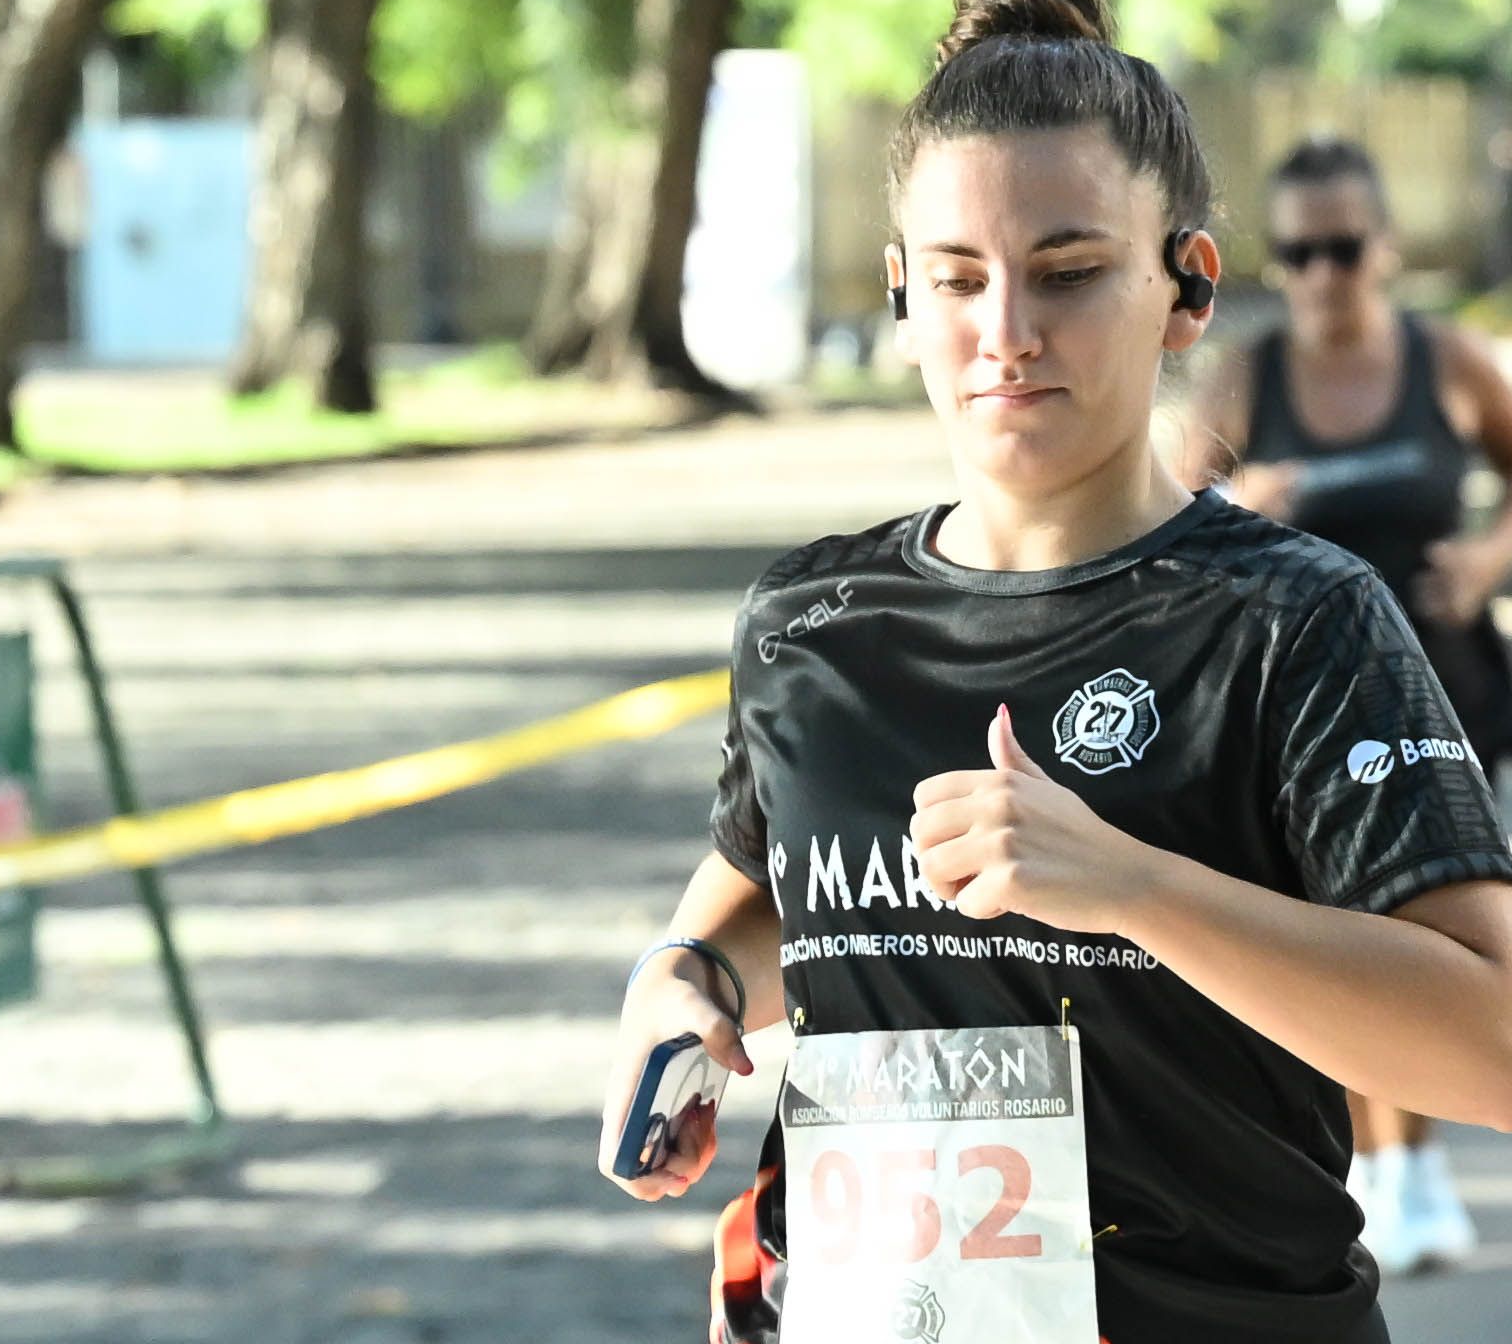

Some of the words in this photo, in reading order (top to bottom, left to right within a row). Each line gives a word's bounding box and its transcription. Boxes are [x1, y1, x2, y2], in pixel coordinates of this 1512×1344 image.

[1084, 701, 1128, 734] 27
[1399, 738, 1465, 766] Banco
[806, 833, 957, 913] MAR
[822, 933, 929, 958] BOMBEROS
[932, 933, 1060, 965] VOLUNTARIOS
[1065, 944, 1159, 970] ROSARIO
[845, 1036, 1026, 1096] MARATÓN
[911, 1099, 1000, 1121] VOLUNTARIOS
[1004, 1097, 1066, 1117] ROSARIO
[810, 1144, 1042, 1264] 952
